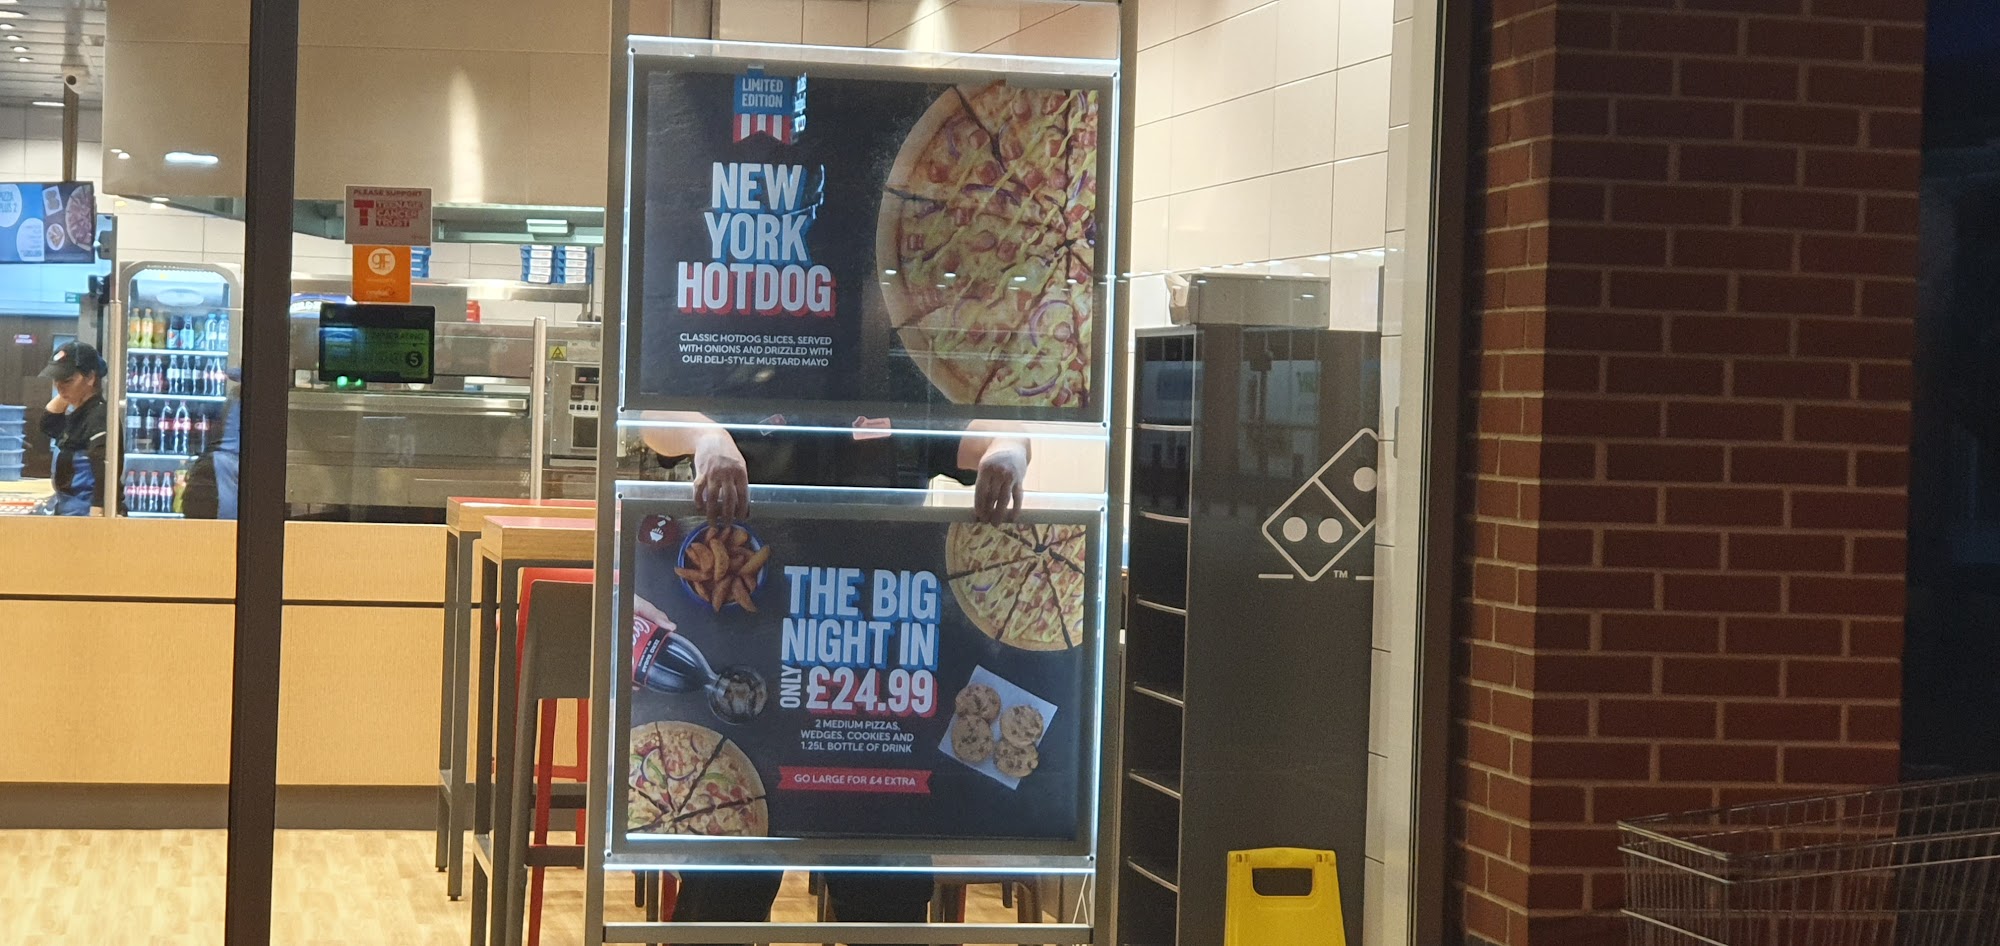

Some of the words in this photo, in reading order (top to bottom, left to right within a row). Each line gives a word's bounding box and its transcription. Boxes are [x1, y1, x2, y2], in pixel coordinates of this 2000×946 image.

[741, 78, 784, 92] LIMITED
[741, 93, 783, 108] EDITION
[711, 162, 803, 211] NEW
[377, 201, 424, 210] TEENAGE
[377, 209, 418, 218] CANCER
[377, 218, 409, 227] TRUST
[703, 212, 808, 261] YORK
[677, 261, 832, 313] HOTDOG
[679, 333, 719, 343] CLASSIC
[720, 334, 761, 344] HOTDOG
[797, 336, 832, 345] SERVED
[678, 344, 703, 353] WITH
[704, 345, 741, 354] ONIONS
[743, 345, 762, 354] AND
[764, 346, 807, 355] DRIZZLED
[809, 347, 833, 356] WITH
[410, 352, 419, 366] 5
[682, 355, 702, 364] OUR
[704, 355, 755, 365] DELI-STYLE
[756, 356, 800, 366] MUSTARD
[801, 357, 829, 367] MAYO
[1333, 570, 1348, 579] TM
[784, 565, 860, 616] THE
[872, 569, 937, 620] BIG
[781, 617, 891, 664] NIGHT
[899, 622, 936, 666] IN
[780, 664, 802, 708] ONLY
[805, 665, 934, 714] £24.99
[815, 719, 821, 728] 2
[822, 719, 864, 729] MEDIUM
[800, 729, 845, 740] WEDGES,
[847, 731, 891, 741] COOKIES
[893, 733, 914, 742] AND
[800, 741, 825, 750] 1.25L
[827, 742, 865, 751] BOTTLE
[866, 743, 880, 752] OF
[882, 744, 912, 753] DRINK
[794, 773, 810, 783] GO
[812, 774, 845, 784] LARGE
[847, 775, 867, 785] FOR
[869, 776, 883, 785] £4
[884, 777, 916, 786] EXTRA
